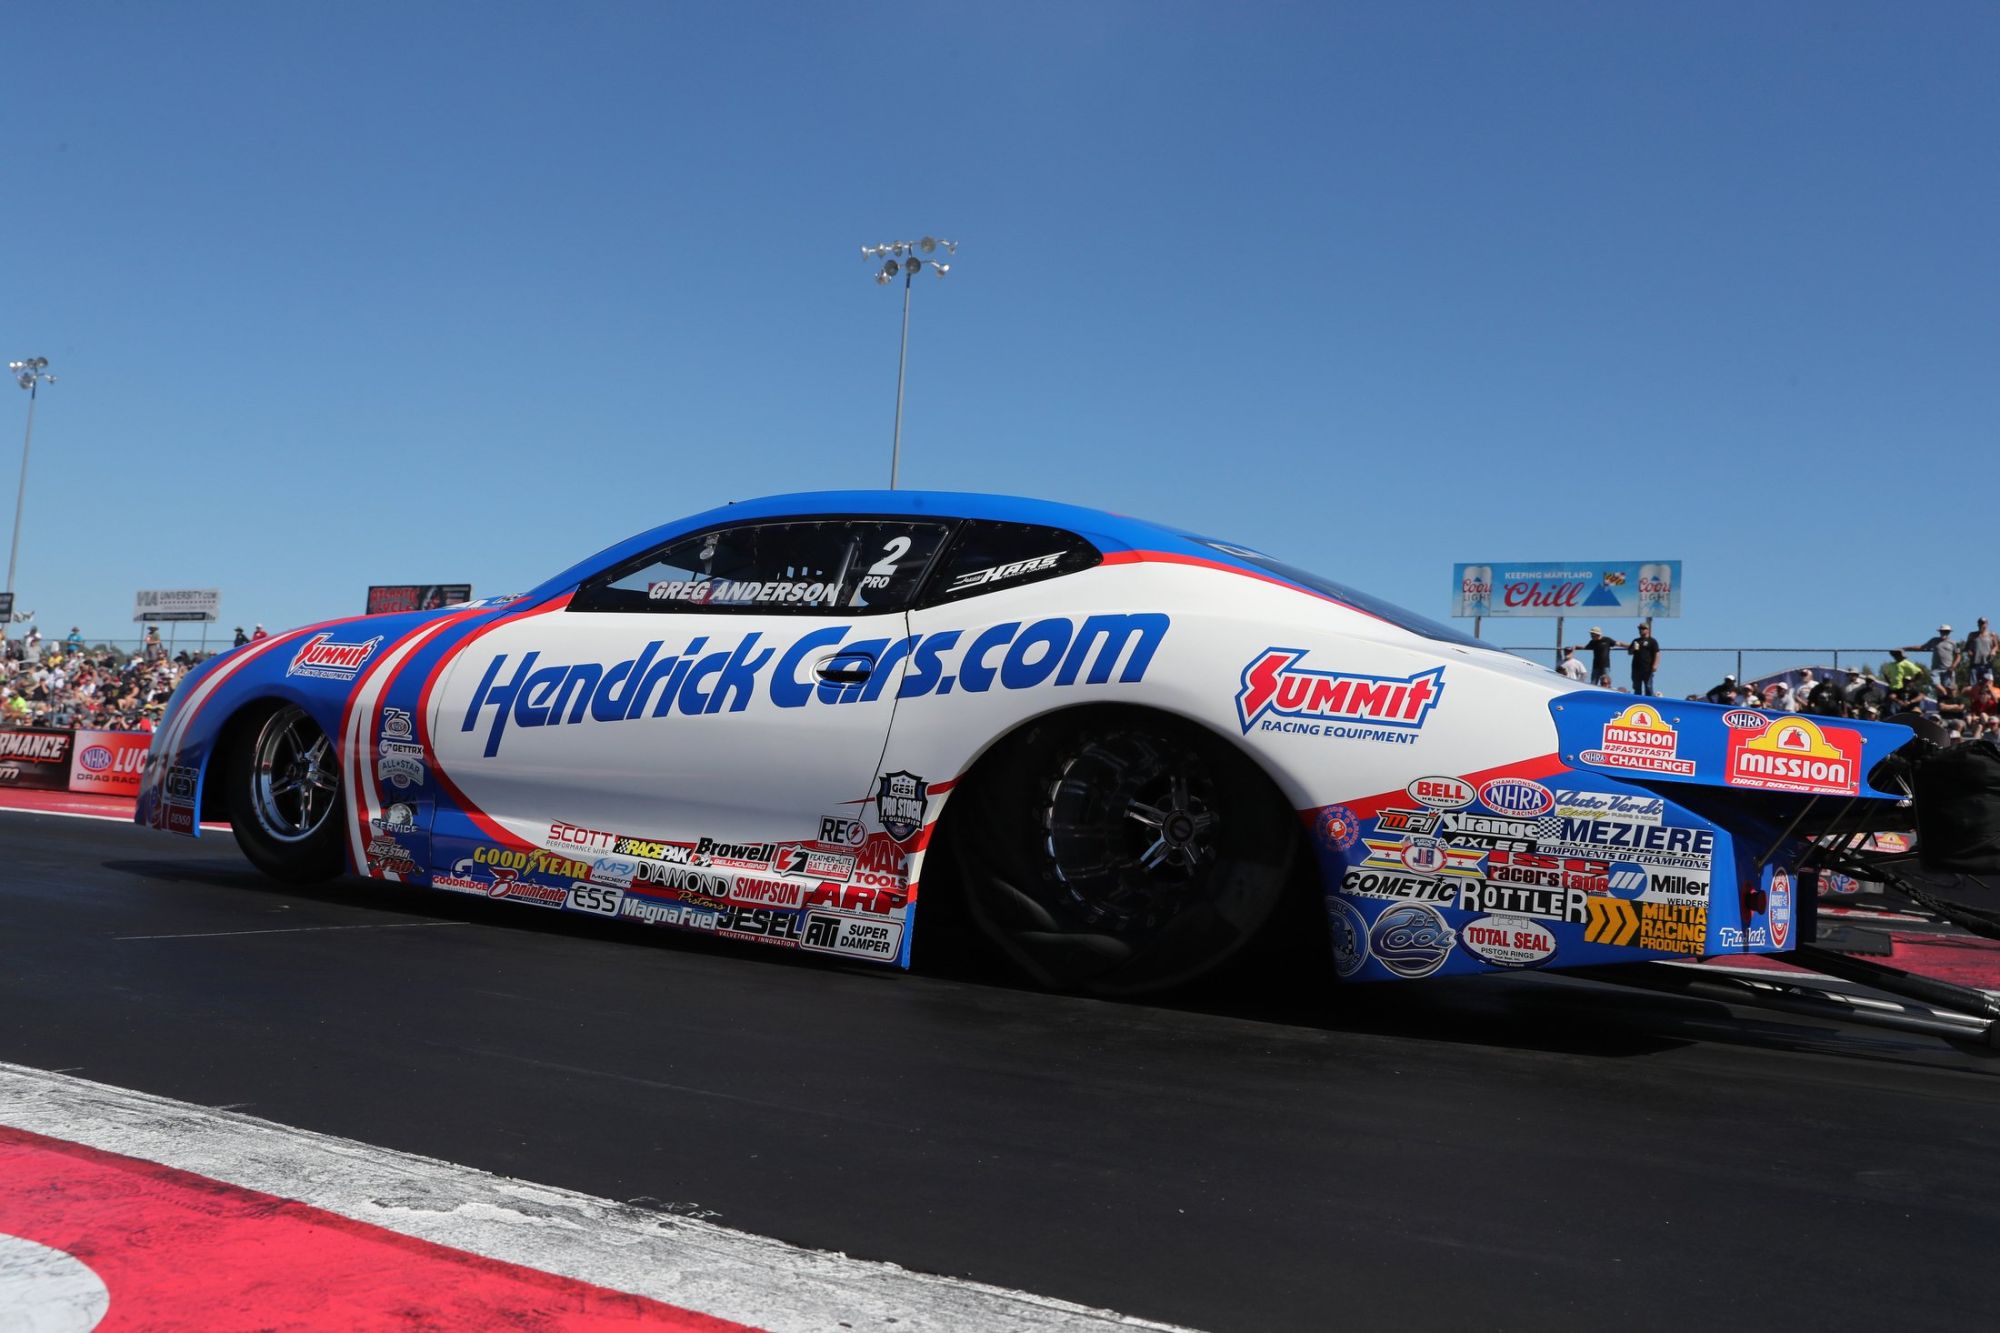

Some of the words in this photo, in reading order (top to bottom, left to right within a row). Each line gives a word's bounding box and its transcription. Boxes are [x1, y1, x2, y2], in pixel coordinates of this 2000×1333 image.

[868, 537, 910, 574] 2
[980, 555, 1060, 583] HAAS
[1505, 571, 1542, 580] KEEPING
[1543, 571, 1592, 579] MARYLAND
[862, 576, 891, 589] PRO
[649, 581, 710, 600] GREG
[711, 581, 843, 604] ANDERSON
[1504, 582, 1585, 608] Chill
[1730, 714, 1761, 727] NHRA
[1261, 720, 1320, 735] RACING
[1324, 726, 1418, 744] EQUIPMENT
[84, 748, 112, 769] NHRA
[1604, 744, 1673, 757] #2FAST2TASTY
[382, 760, 395, 769] ALL
[400, 760, 420, 775] STAR
[1582, 753, 1606, 763] NHRA
[1610, 755, 1690, 773] CHALLENGE
[77, 773, 111, 783] DRAG
[1492, 779, 1542, 790] CHAMPIONSHIP
[1731, 778, 1763, 786] DRAG
[1766, 781, 1809, 791] RACING
[1417, 781, 1466, 800] BELL
[1422, 796, 1459, 804] HELMETS
[1490, 785, 1542, 810] NHRA
[881, 797, 897, 817] PRO
[898, 799, 922, 821] STOCK
[1489, 804, 1508, 815] DRAG
[1556, 791, 1607, 809] Auto
[1608, 796, 1664, 815] Verdi
[372, 819, 418, 833] SERVICE
[888, 816, 921, 828] QUALIFIER
[1442, 811, 1540, 839] Strange
[548, 824, 613, 848] SCOTT
[1449, 836, 1528, 853] AXLES
[1561, 819, 1713, 854] MEZIERE
[545, 840, 592, 853] PERFORMANCE
[628, 839, 692, 864] RACEPAK
[695, 837, 776, 862] Browell
[713, 858, 767, 871] BELLHOUSING
[1536, 845, 1615, 861] COMPONENTS
[1620, 853, 1634, 863] OF
[1636, 855, 1710, 869] CHAMPIONS
[807, 862, 850, 874] BATTERIES
[432, 876, 488, 891] GOODRIDGE
[637, 861, 730, 898] DIAMOND
[855, 872, 908, 889] TOOLS
[1651, 874, 1709, 896] Miller
[574, 885, 616, 913] ESS
[677, 891, 725, 910] Pistons
[733, 879, 800, 906] SIMPSON
[806, 881, 909, 915] ARP
[1459, 878, 1587, 924] ROTTLER
[1667, 897, 1709, 908] WELDERS
[621, 898, 719, 931] MagnaFuel
[716, 905, 801, 941] JESEL
[718, 931, 755, 942] VALVETRAIN
[758, 937, 796, 948] INNOVATION
[849, 924, 888, 940] SUPER
[1468, 927, 1510, 948] TOTAL
[1514, 931, 1551, 952] SEAL
[1641, 920, 1707, 941] RACING
[840, 936, 891, 953] DAMPER
[1481, 947, 1508, 957] PISTON
[1510, 951, 1535, 960] RINGS
[1640, 938, 1705, 956] PRODUCTS
